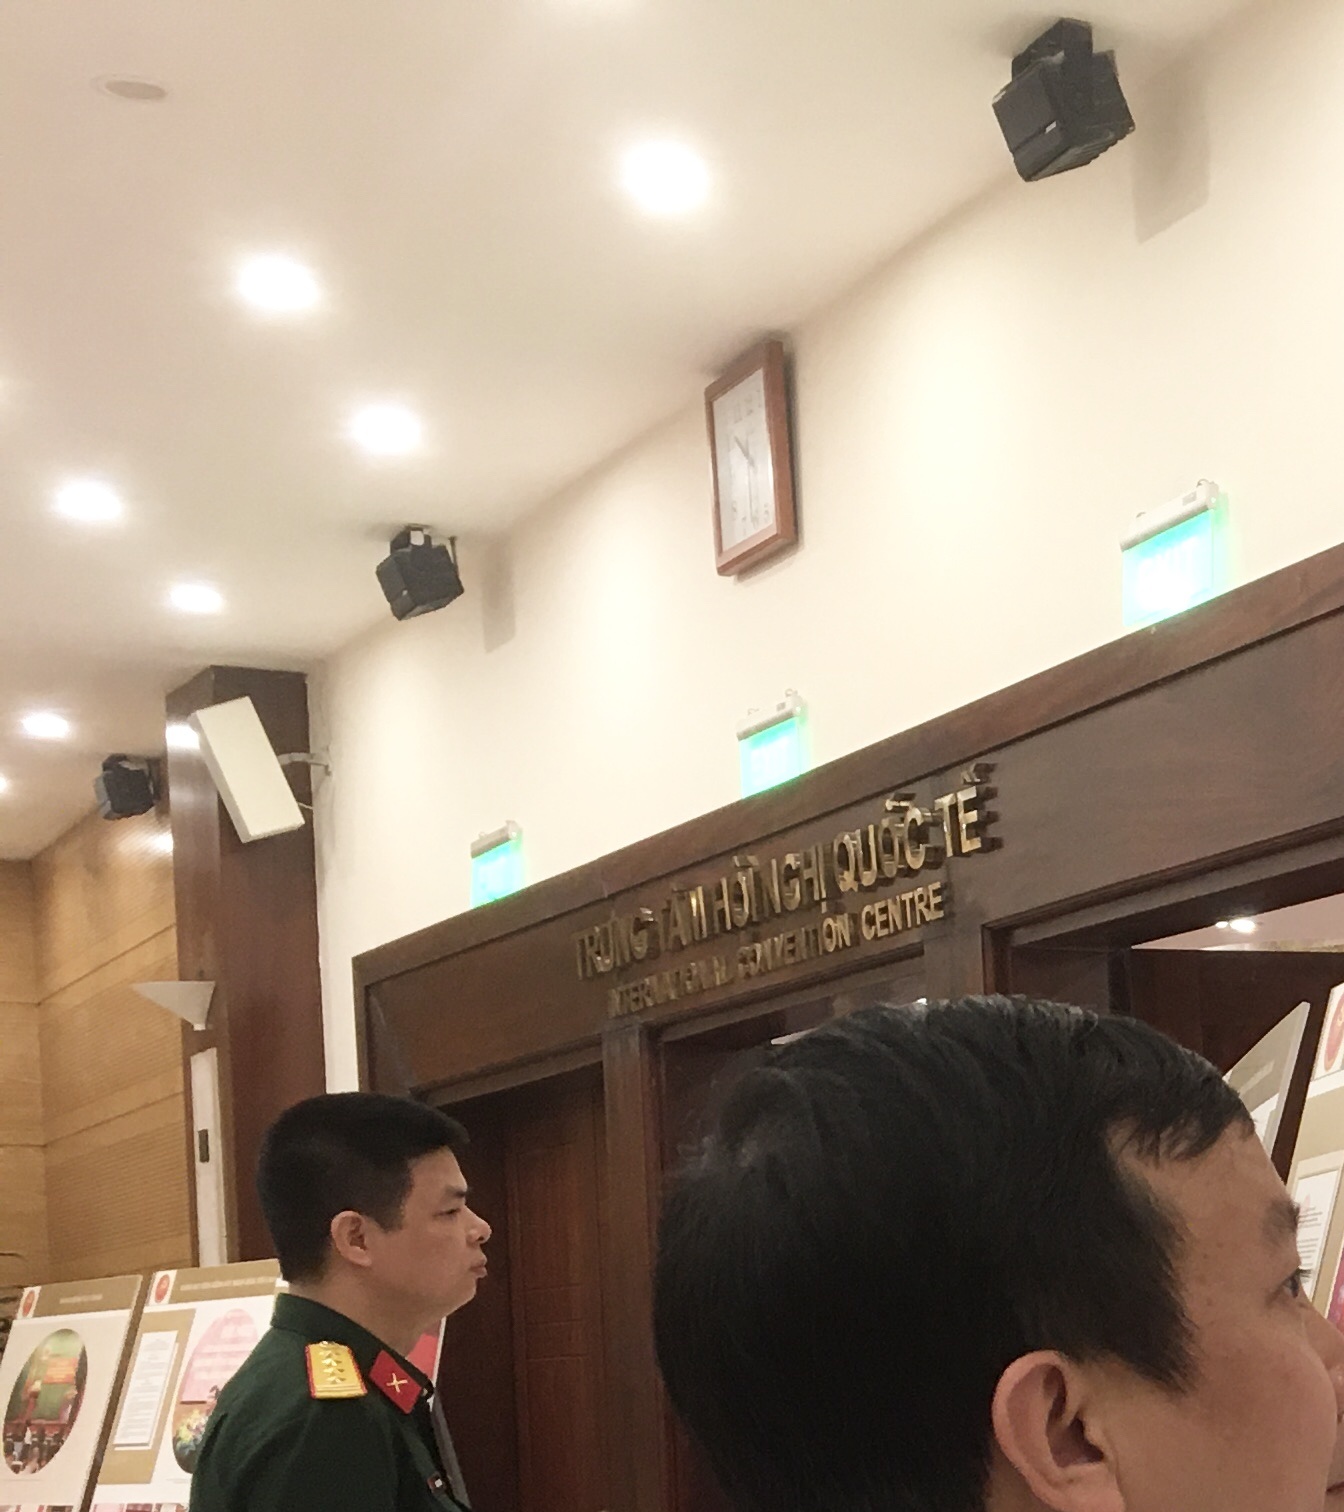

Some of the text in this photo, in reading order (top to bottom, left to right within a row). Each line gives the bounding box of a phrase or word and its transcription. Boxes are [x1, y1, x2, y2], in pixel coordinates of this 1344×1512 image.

[572, 763, 984, 981] TRUNG TÂM HỘI NGHỊ QUỐC TẾ
[862, 882, 945, 940] CENTRE
